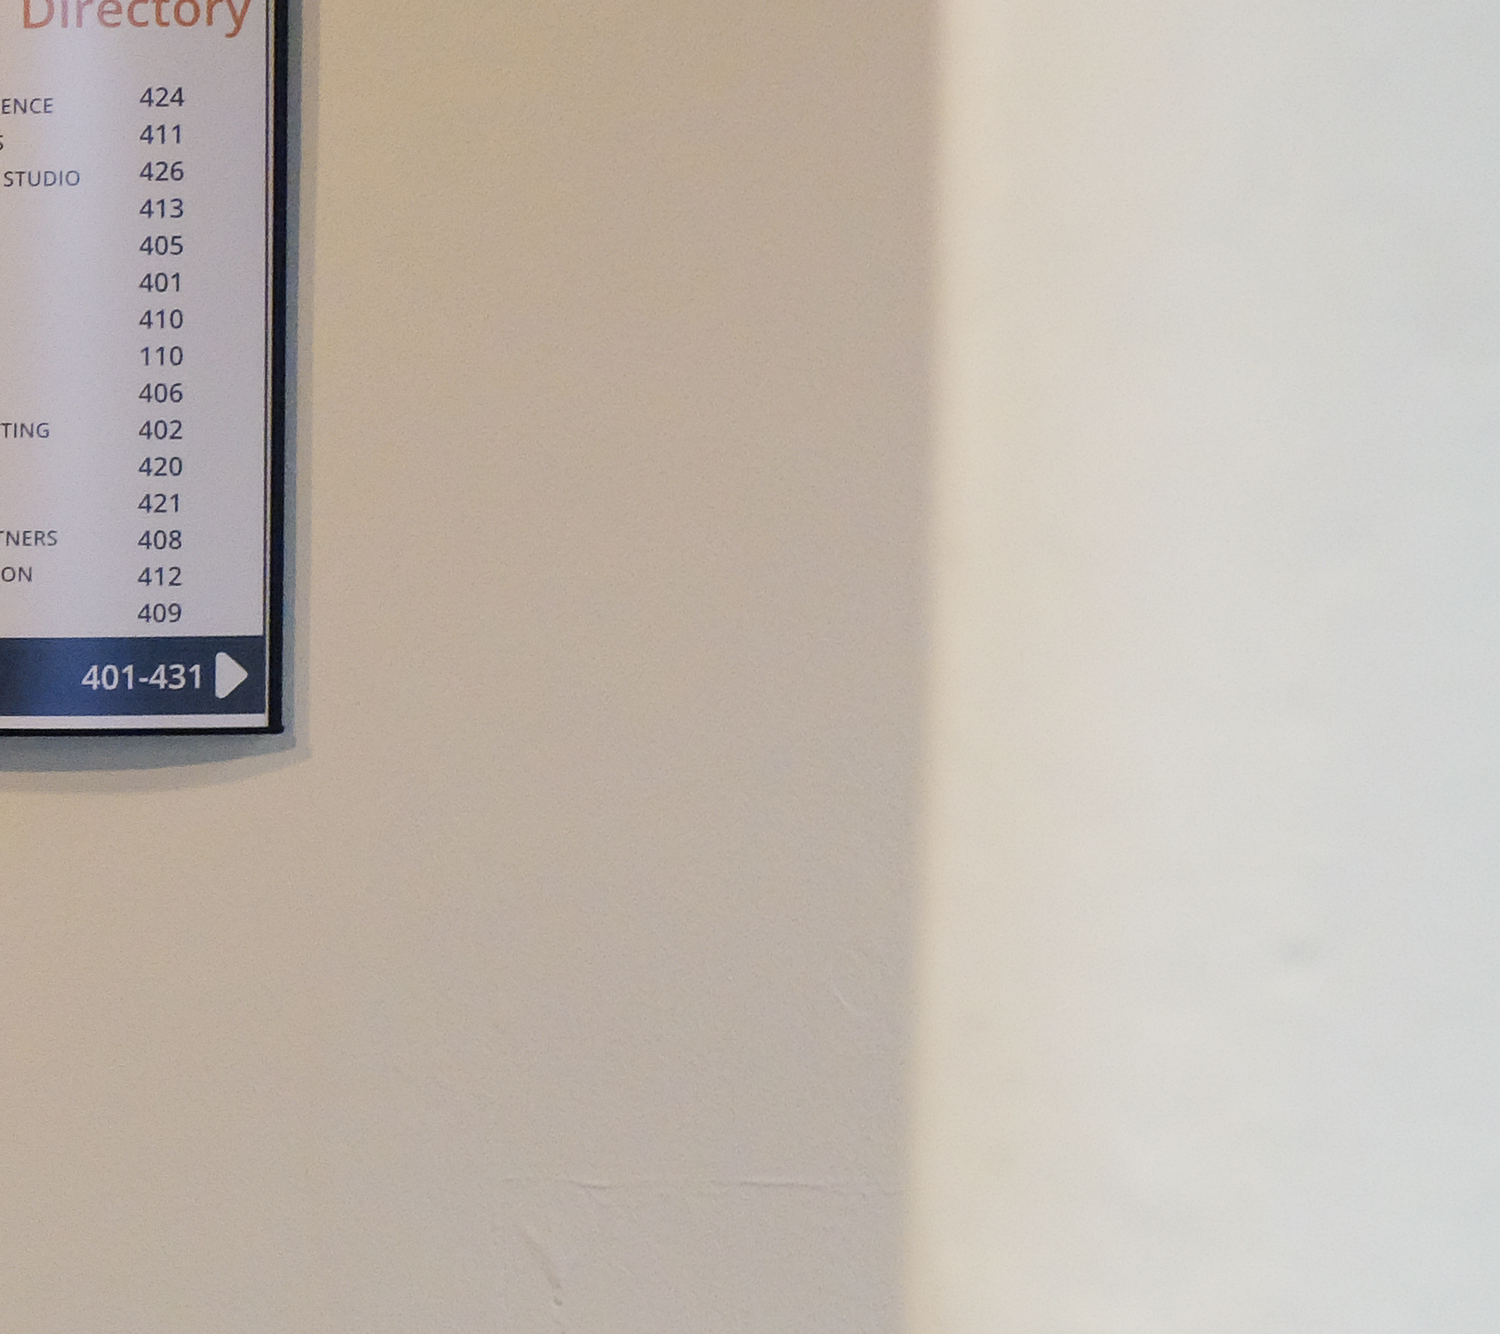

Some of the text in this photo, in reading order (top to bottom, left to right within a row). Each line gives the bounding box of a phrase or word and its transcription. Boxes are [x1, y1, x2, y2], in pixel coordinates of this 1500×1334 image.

[139, 86, 185, 108] 424
[139, 124, 181, 145] 411
[3, 170, 81, 188] STUDIO
[139, 160, 185, 182] 426
[139, 197, 184, 219] 413
[139, 235, 184, 256] 405
[138, 271, 181, 293] 401
[138, 308, 184, 330] 410
[140, 345, 184, 367] 110
[138, 382, 184, 404] 406
[138, 419, 183, 441] 402
[138, 456, 183, 477] 420
[137, 492, 179, 514] 421
[137, 529, 183, 551] 408
[137, 565, 182, 587] 412
[137, 602, 183, 624] 409
[81, 663, 201, 691] 401-431
